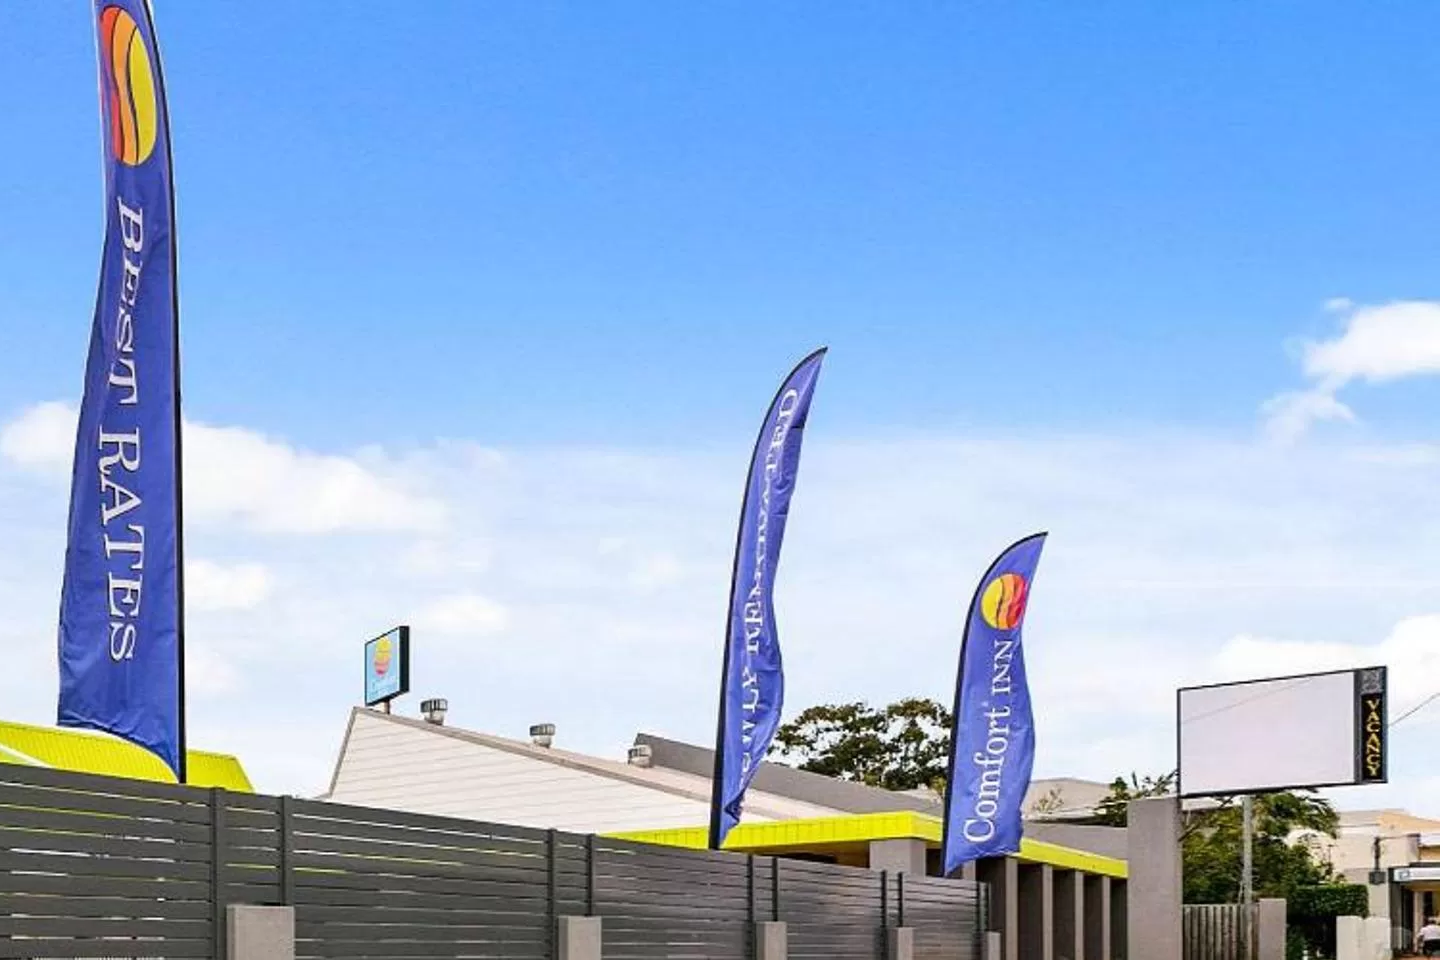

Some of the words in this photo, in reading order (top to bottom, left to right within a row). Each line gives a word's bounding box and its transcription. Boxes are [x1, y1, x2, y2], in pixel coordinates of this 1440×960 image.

[108, 196, 143, 405] BEST
[98, 424, 145, 662] RATES
[963, 705, 1011, 842] Comfort
[991, 639, 1014, 697] INN
[1366, 699, 1381, 776] VACANCY
